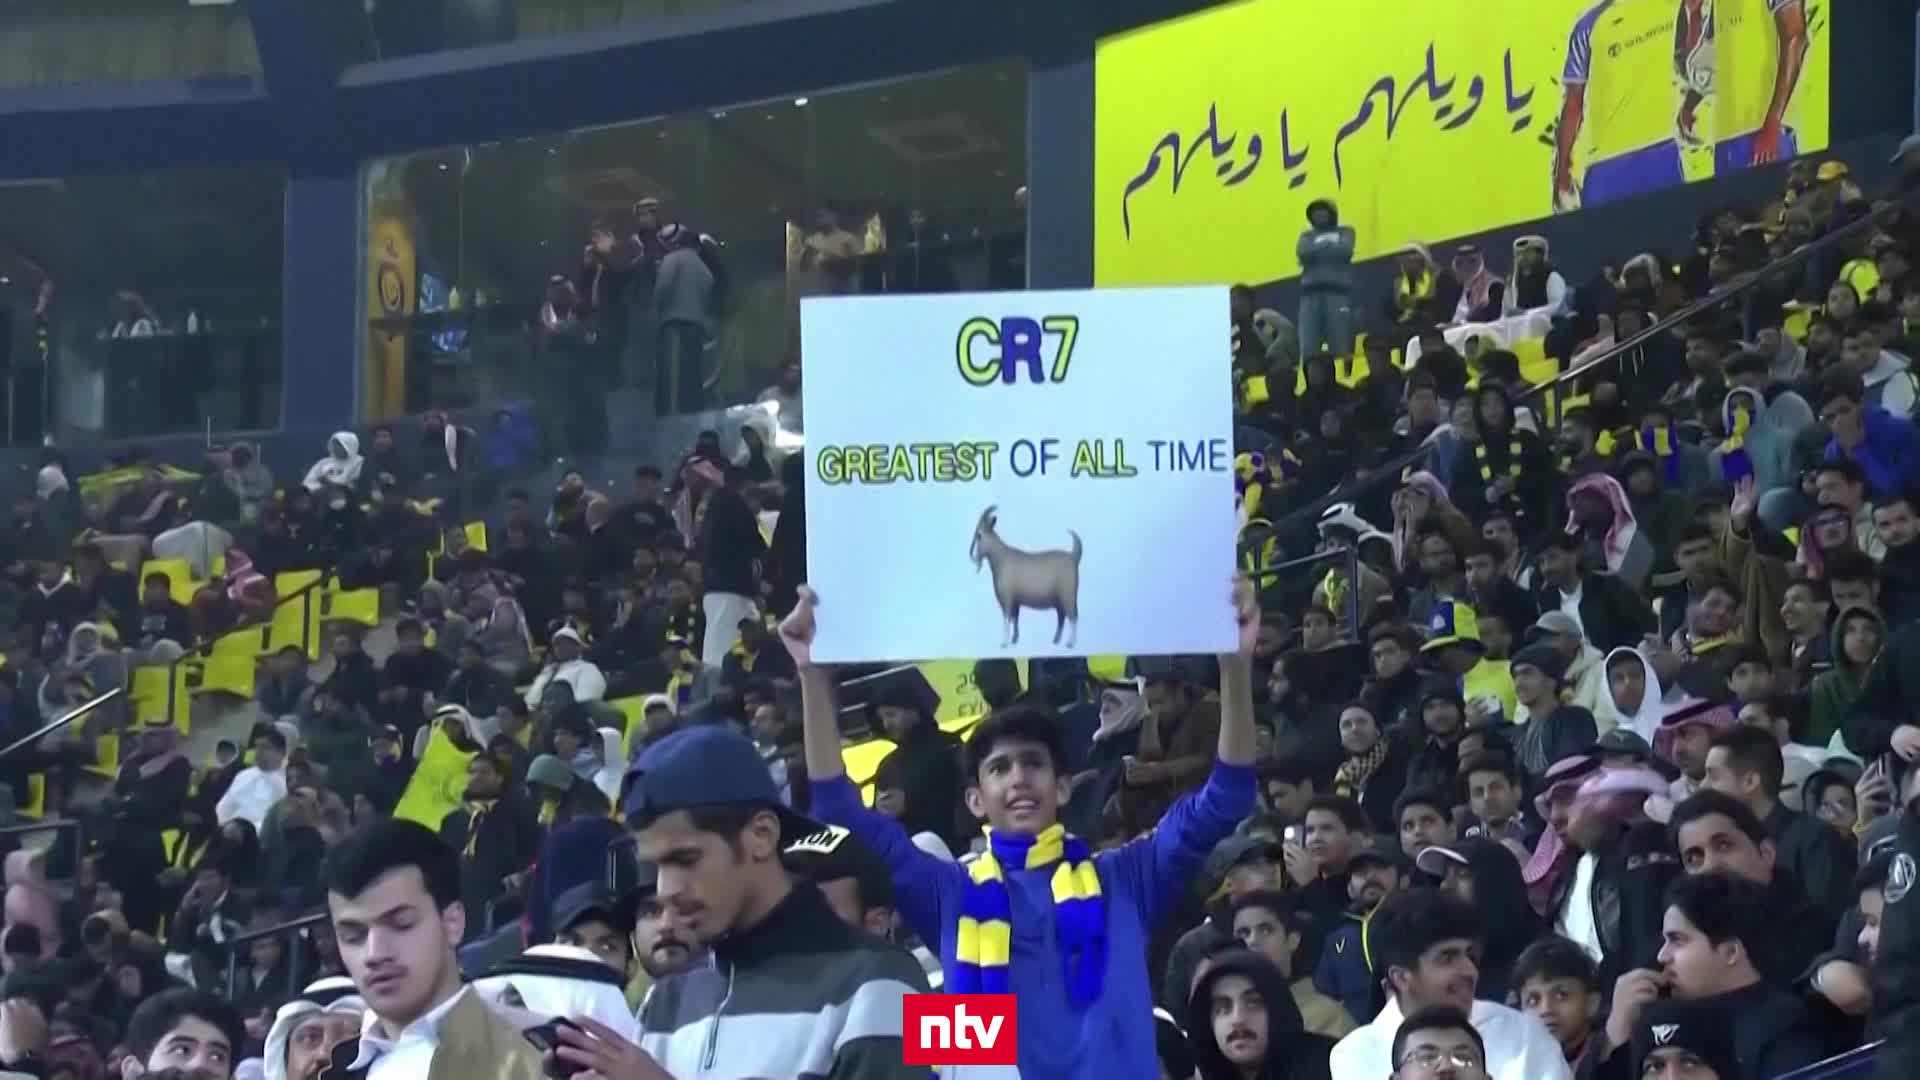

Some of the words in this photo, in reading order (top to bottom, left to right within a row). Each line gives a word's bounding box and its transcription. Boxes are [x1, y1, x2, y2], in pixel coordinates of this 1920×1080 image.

[1334, 39, 1484, 191] ويلهم
[1503, 48, 1535, 134] يا
[1122, 100, 1262, 241] ويلهم
[1280, 106, 1310, 191] يا
[956, 315, 1079, 386] CR7
[817, 441, 998, 484] GREATEST
[1009, 438, 1060, 477] OF
[1071, 438, 1138, 478] ALL
[1147, 439, 1228, 473] TIME
